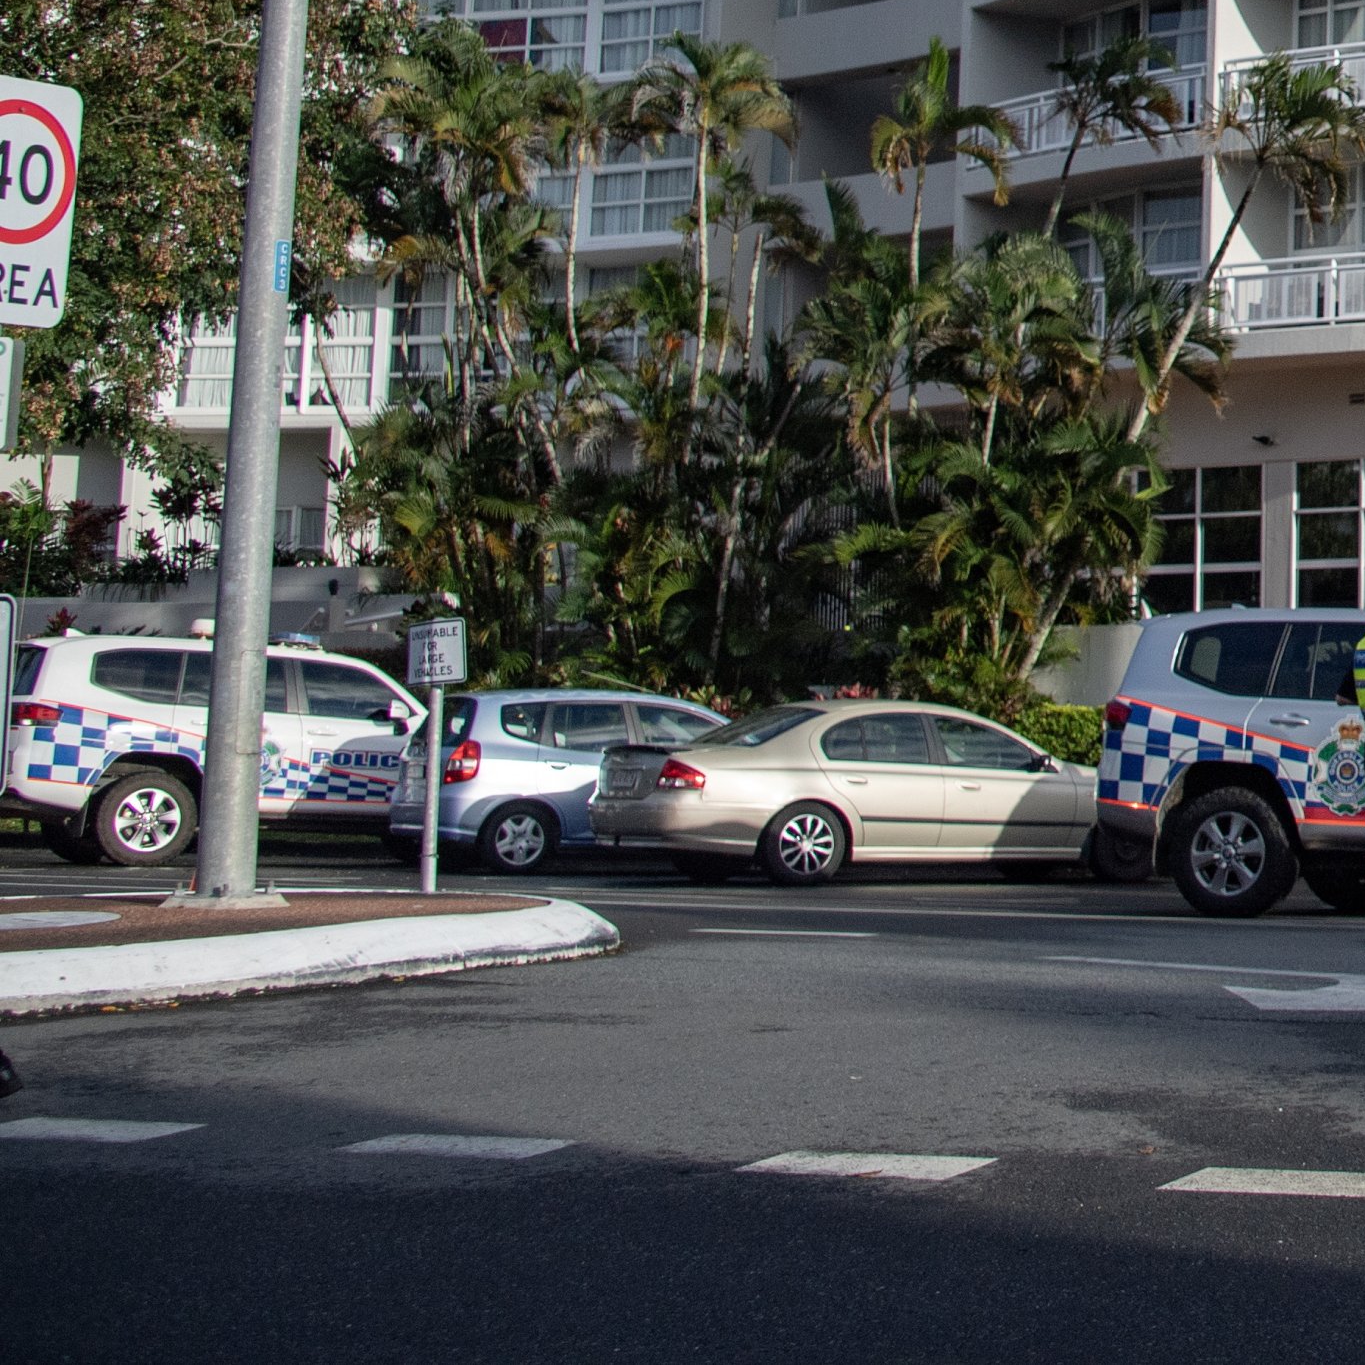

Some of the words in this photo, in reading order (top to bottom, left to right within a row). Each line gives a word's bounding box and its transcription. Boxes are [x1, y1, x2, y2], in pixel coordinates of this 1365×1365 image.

[423, 641, 438, 652] FOR
[418, 653, 445, 666] LARGE
[414, 665, 453, 679] VEHICLES
